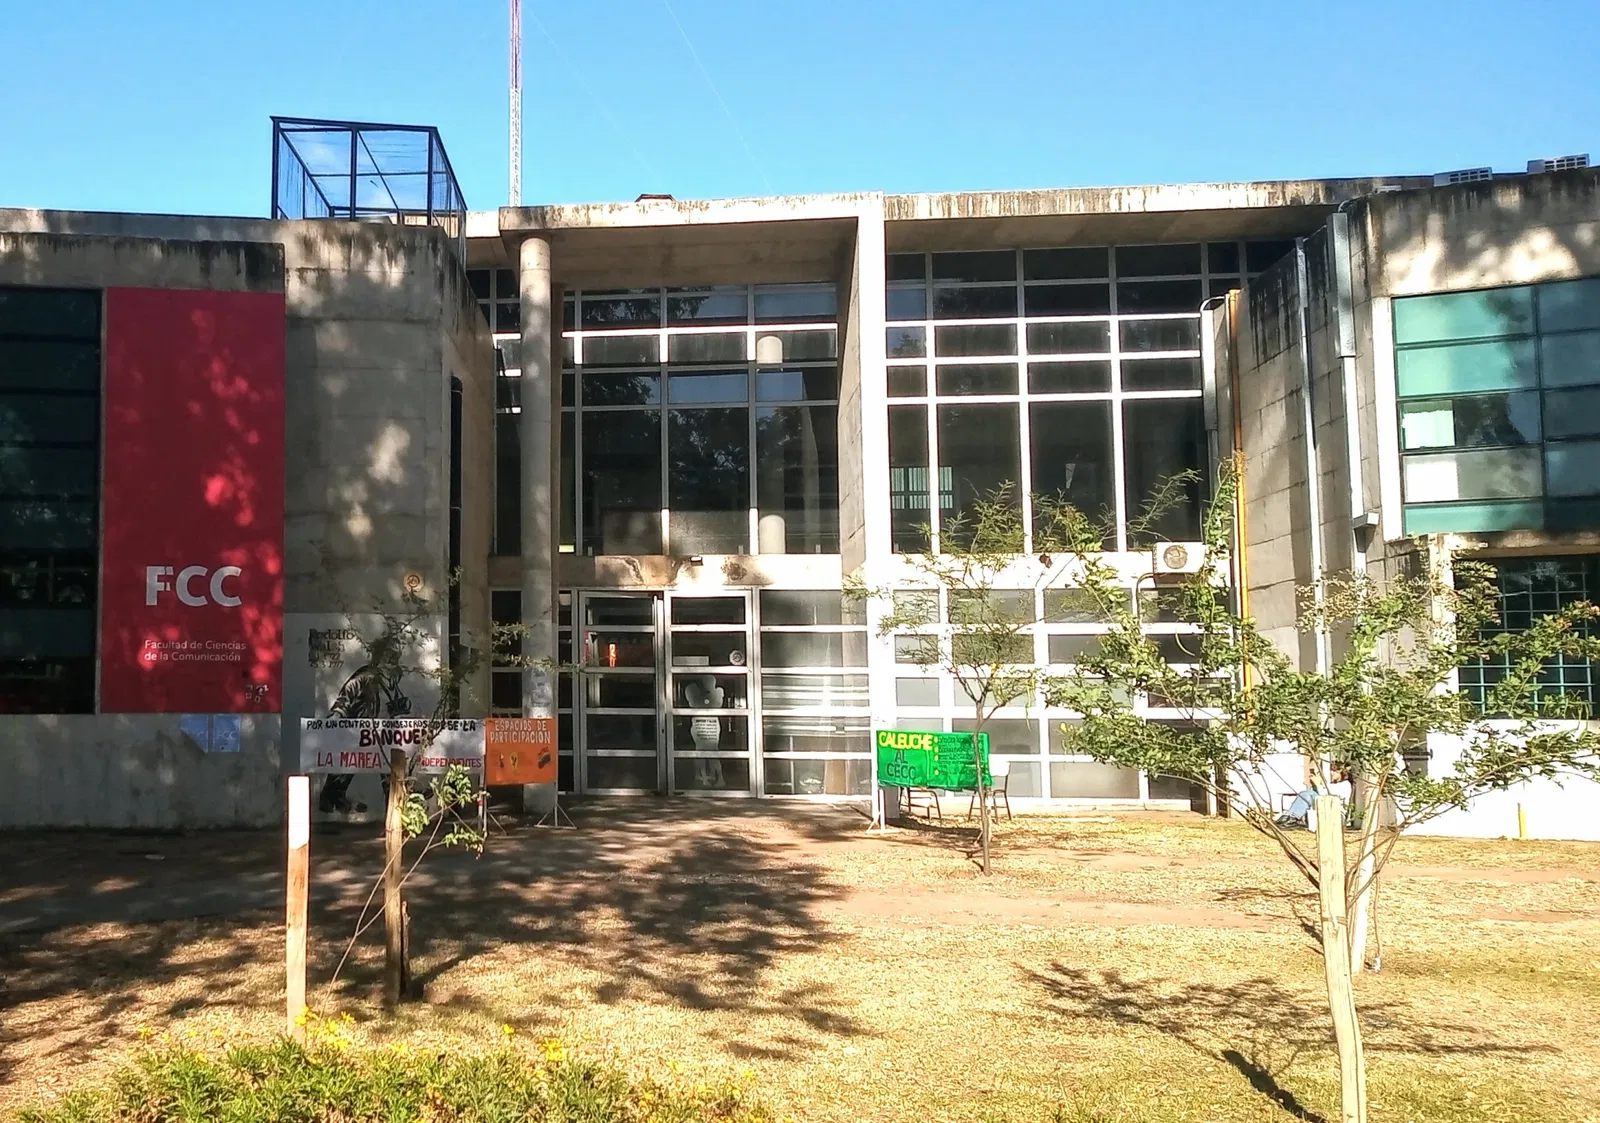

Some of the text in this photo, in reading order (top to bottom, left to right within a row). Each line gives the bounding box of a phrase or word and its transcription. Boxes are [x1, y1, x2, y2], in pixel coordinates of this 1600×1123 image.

[145, 565, 242, 607] FCC
[144, 640, 247, 650] Facultad de Ciencias
[144, 652, 241, 661] de la Comunicación
[307, 720, 322, 730] POR
[326, 720, 338, 729] UN
[339, 719, 371, 729] CENTRO
[494, 720, 547, 732] ESPACIOS DE
[317, 752, 382, 769] LA MAREA
[895, 750, 908, 764] AL
